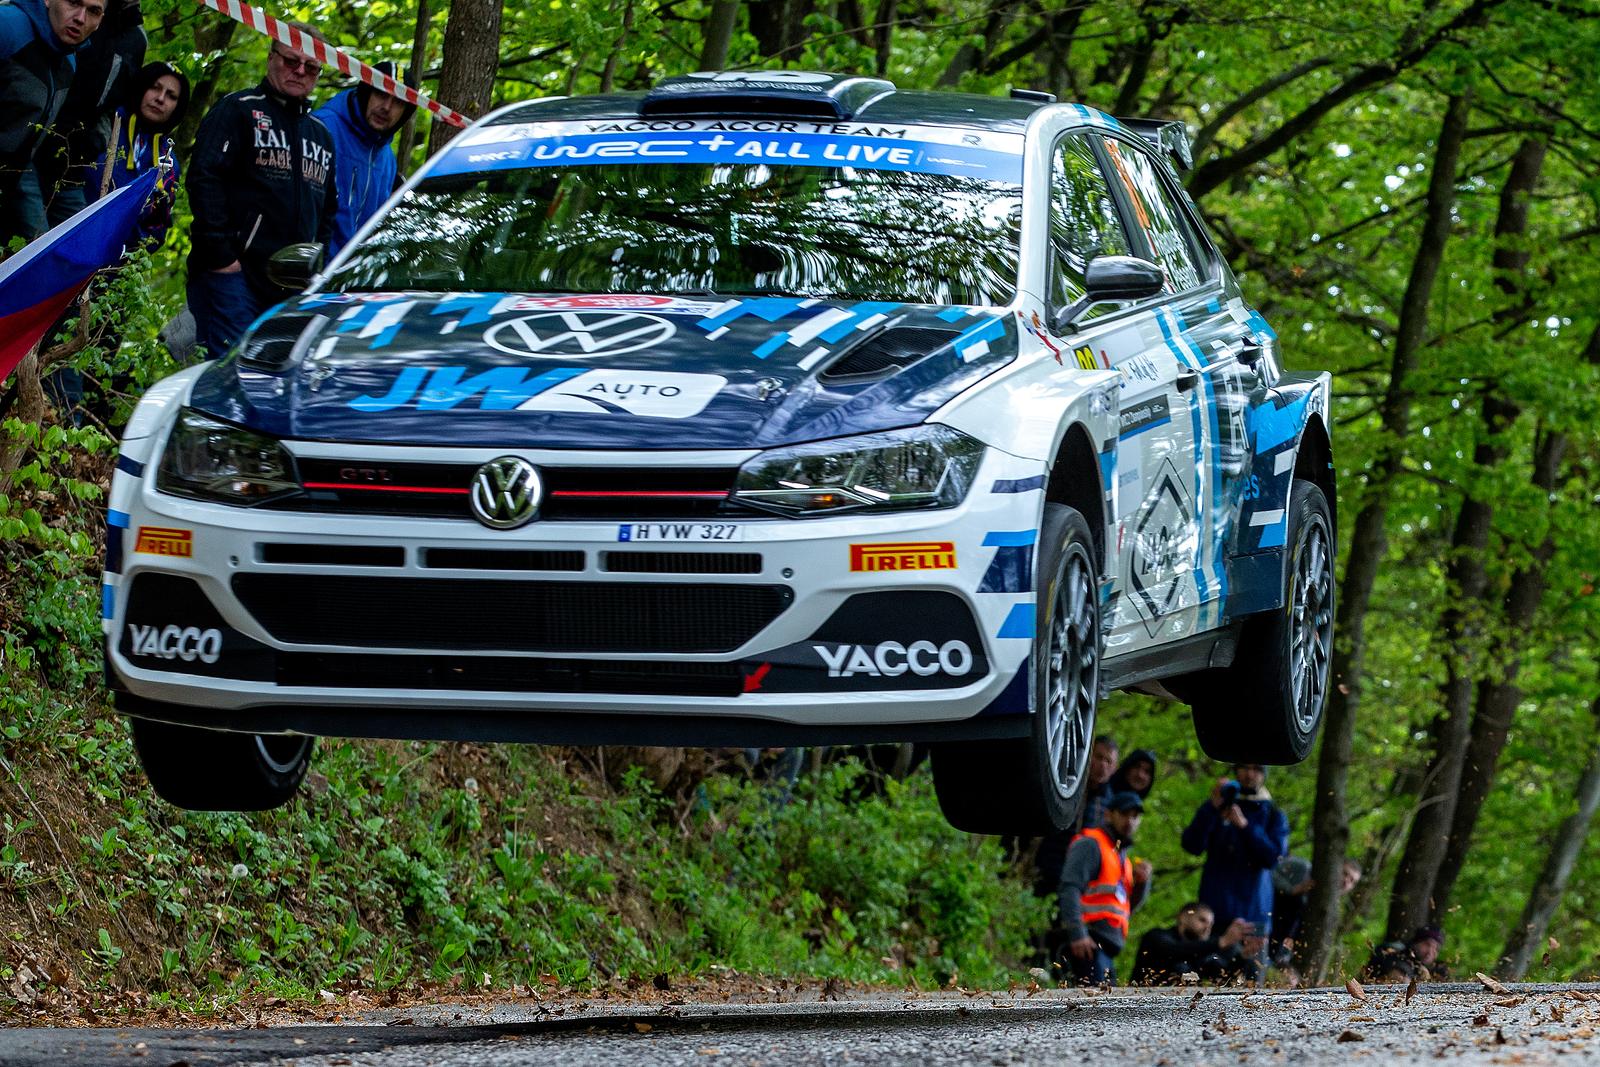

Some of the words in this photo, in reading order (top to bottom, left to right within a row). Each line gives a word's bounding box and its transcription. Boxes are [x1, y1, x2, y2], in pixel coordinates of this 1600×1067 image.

[586, 120, 697, 133] YACCO
[703, 120, 799, 134] ACCR
[810, 122, 908, 139] TEAM
[734, 140, 811, 159] ALL
[823, 143, 915, 165] LIVE
[588, 382, 682, 399] AUTO
[636, 524, 650, 539] H
[659, 524, 694, 539] VW
[700, 524, 738, 540] 327
[850, 543, 956, 572] PIRELLI
[128, 623, 223, 664] YACCO
[813, 640, 973, 677] YACCO
